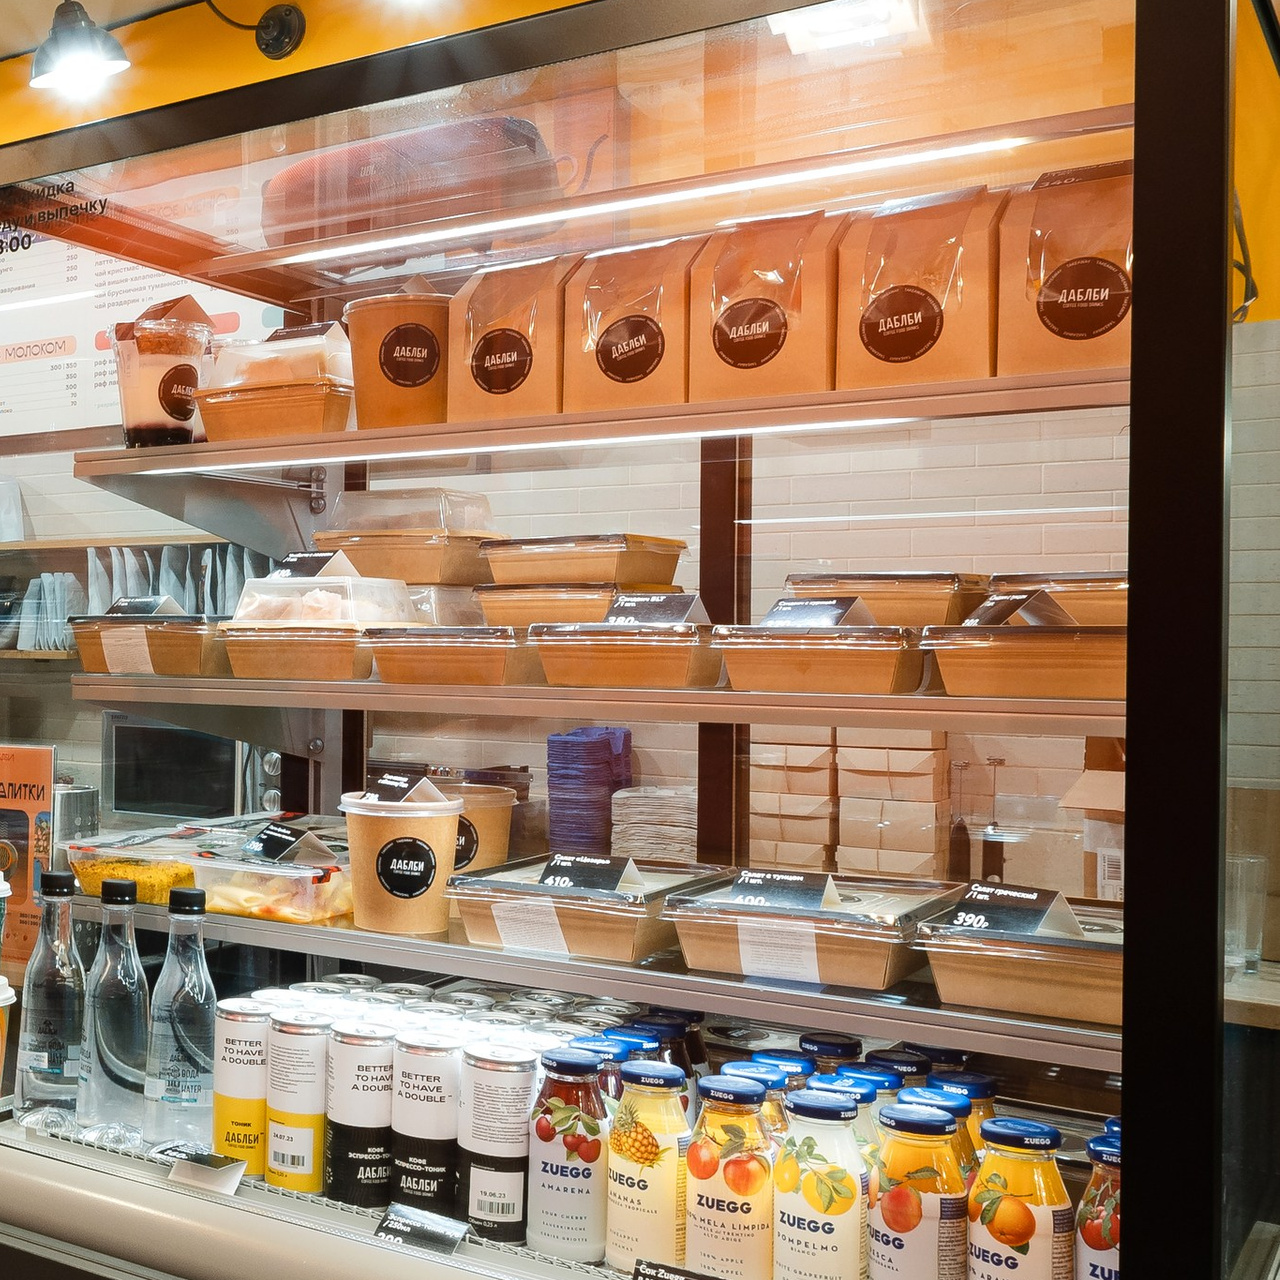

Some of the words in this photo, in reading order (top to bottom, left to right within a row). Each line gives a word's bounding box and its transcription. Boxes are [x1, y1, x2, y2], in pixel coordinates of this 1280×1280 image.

[25, 217, 33, 225] и
[38, 198, 108, 222] выпечку
[1058, 288, 1109, 304] ДАБЛБИ
[878, 312, 922, 332] ДАБЛБИ
[729, 321, 770, 339] ДАБЛБИ
[5, 340, 66, 360] МОЛОКОМ
[393, 346, 428, 358] ДАБЛБИ
[611, 334, 647, 358] ДАБЛБИ
[484, 351, 518, 367] ДАБЛБИ
[390, 859, 425, 871] ДАБЛБИ
[741, 870, 766, 878] Салат
[773, 873, 804, 882] тунцом
[971, 883, 995, 894] Салат
[995, 887, 1038, 901] греческий
[953, 912, 989, 929] 390р
[225, 1038, 262, 1047] BETTER
[229, 1057, 267, 1066] DOUBLE
[357, 1064, 393, 1072] BETTER
[182, 1069, 200, 1079] ВОДА
[355, 1074, 369, 1082] TO
[401, 1070, 441, 1083] BETTER
[400, 1080, 411, 1089] TO
[413, 1084, 442, 1093] HAVE
[641, 1077, 664, 1085] ZUEGG
[181, 1085, 202, 1094] WATER
[710, 1090, 734, 1100] ZUEGG
[943, 1085, 969, 1095] ZUEGG
[405, 1092, 446, 1103] DOUBLE
[225, 1131, 259, 1144] ДАБЛБИ
[1024, 1137, 1051, 1145] ZUEGG
[394, 1159, 446, 1173] ЭСПРЕССО-ТОНИК
[409, 1157, 427, 1165] КОФЕ
[541, 1161, 592, 1179] ZUEGG
[400, 1175, 438, 1192] ДАБЛБИ
[608, 1167, 649, 1191] ZUEGG
[480, 1190, 506, 1199] 19.06.23
[541, 1182, 591, 1195] AMARENA
[609, 1190, 642, 1206] ANANAS
[696, 1193, 752, 1214] ZUEGG
[541, 1210, 558, 1218] SOUR
[383, 1220, 411, 1232] /250мл
[699, 1217, 726, 1229] MELA
[732, 1223, 770, 1231] LIMPIDA
[780, 1210, 835, 1235] ZUEGG
[777, 1231, 839, 1253] POMPELMO
[969, 1242, 1019, 1270] ZUEGG
[639, 1264, 656, 1276] Сок
[793, 1269, 843, 1280] GRAPEFRUIT
